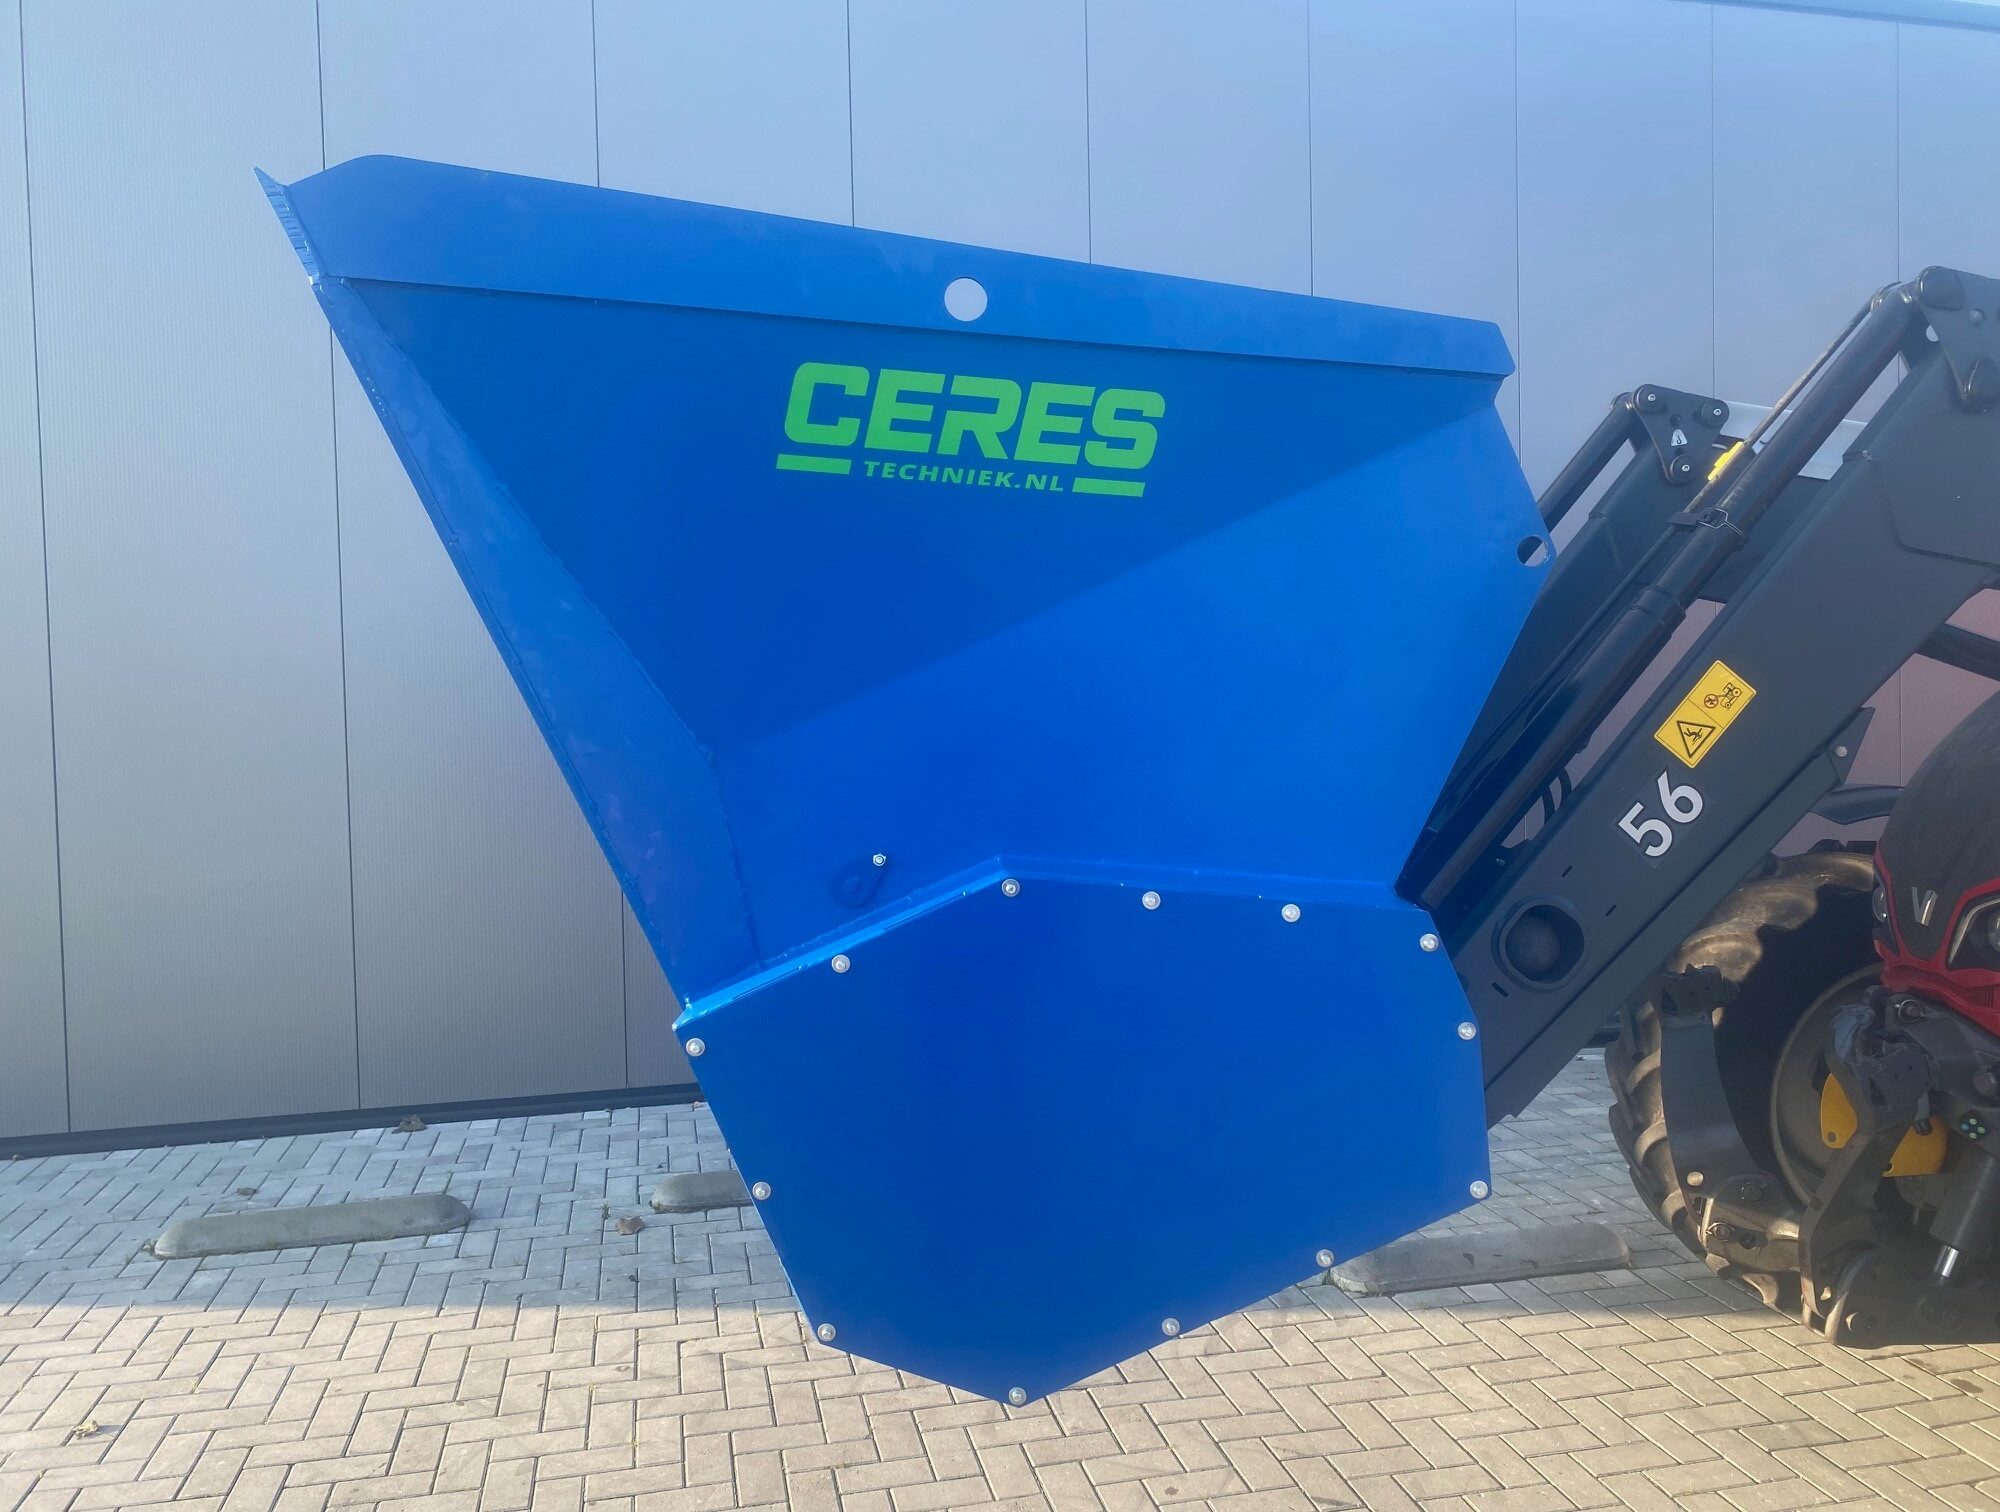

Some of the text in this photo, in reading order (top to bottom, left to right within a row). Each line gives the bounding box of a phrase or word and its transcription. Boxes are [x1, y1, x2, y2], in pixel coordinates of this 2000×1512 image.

[784, 361, 1167, 470] CERES
[864, 460, 1064, 492] TECHNIEK.NL
[1618, 771, 1703, 857] 56
